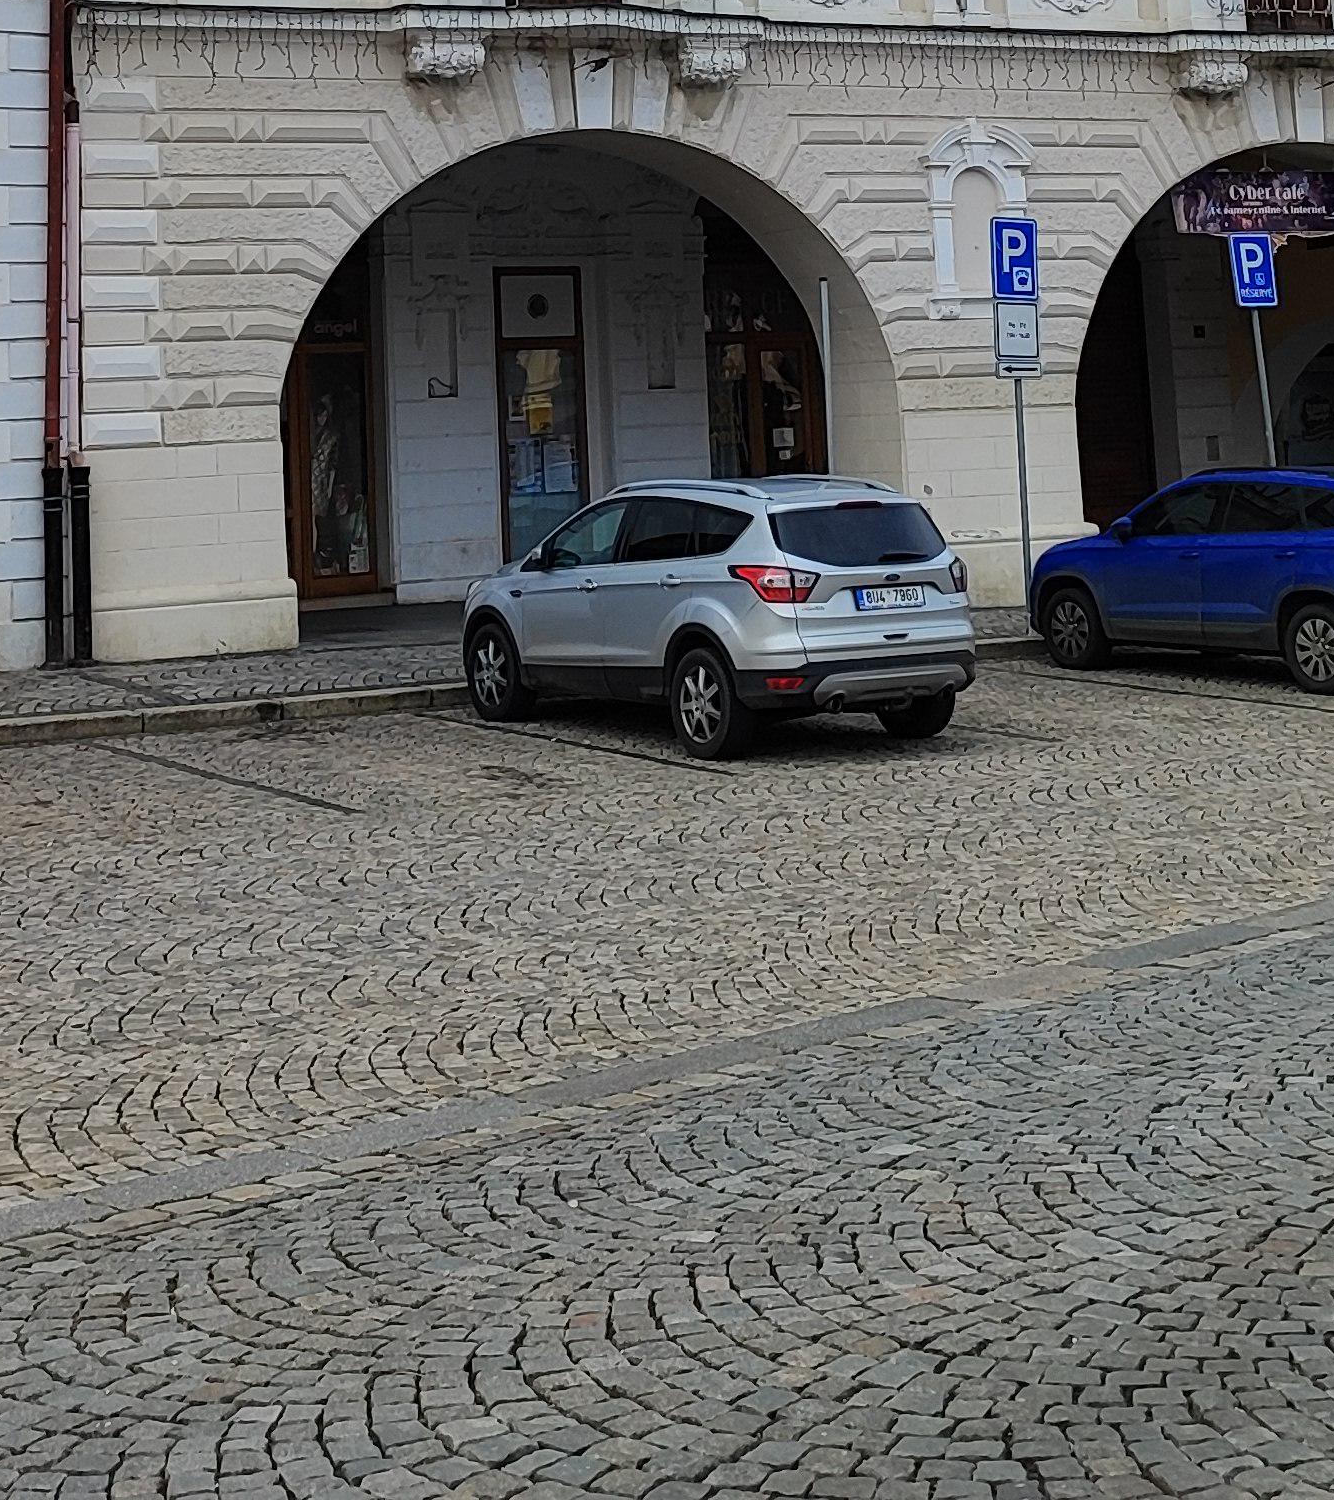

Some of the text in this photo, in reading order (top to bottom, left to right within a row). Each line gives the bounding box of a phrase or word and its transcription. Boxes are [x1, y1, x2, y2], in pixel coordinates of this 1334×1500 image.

[1229, 184, 1272, 201] Cyber
[1002, 228, 1027, 273] P
[1239, 242, 1264, 284] P
